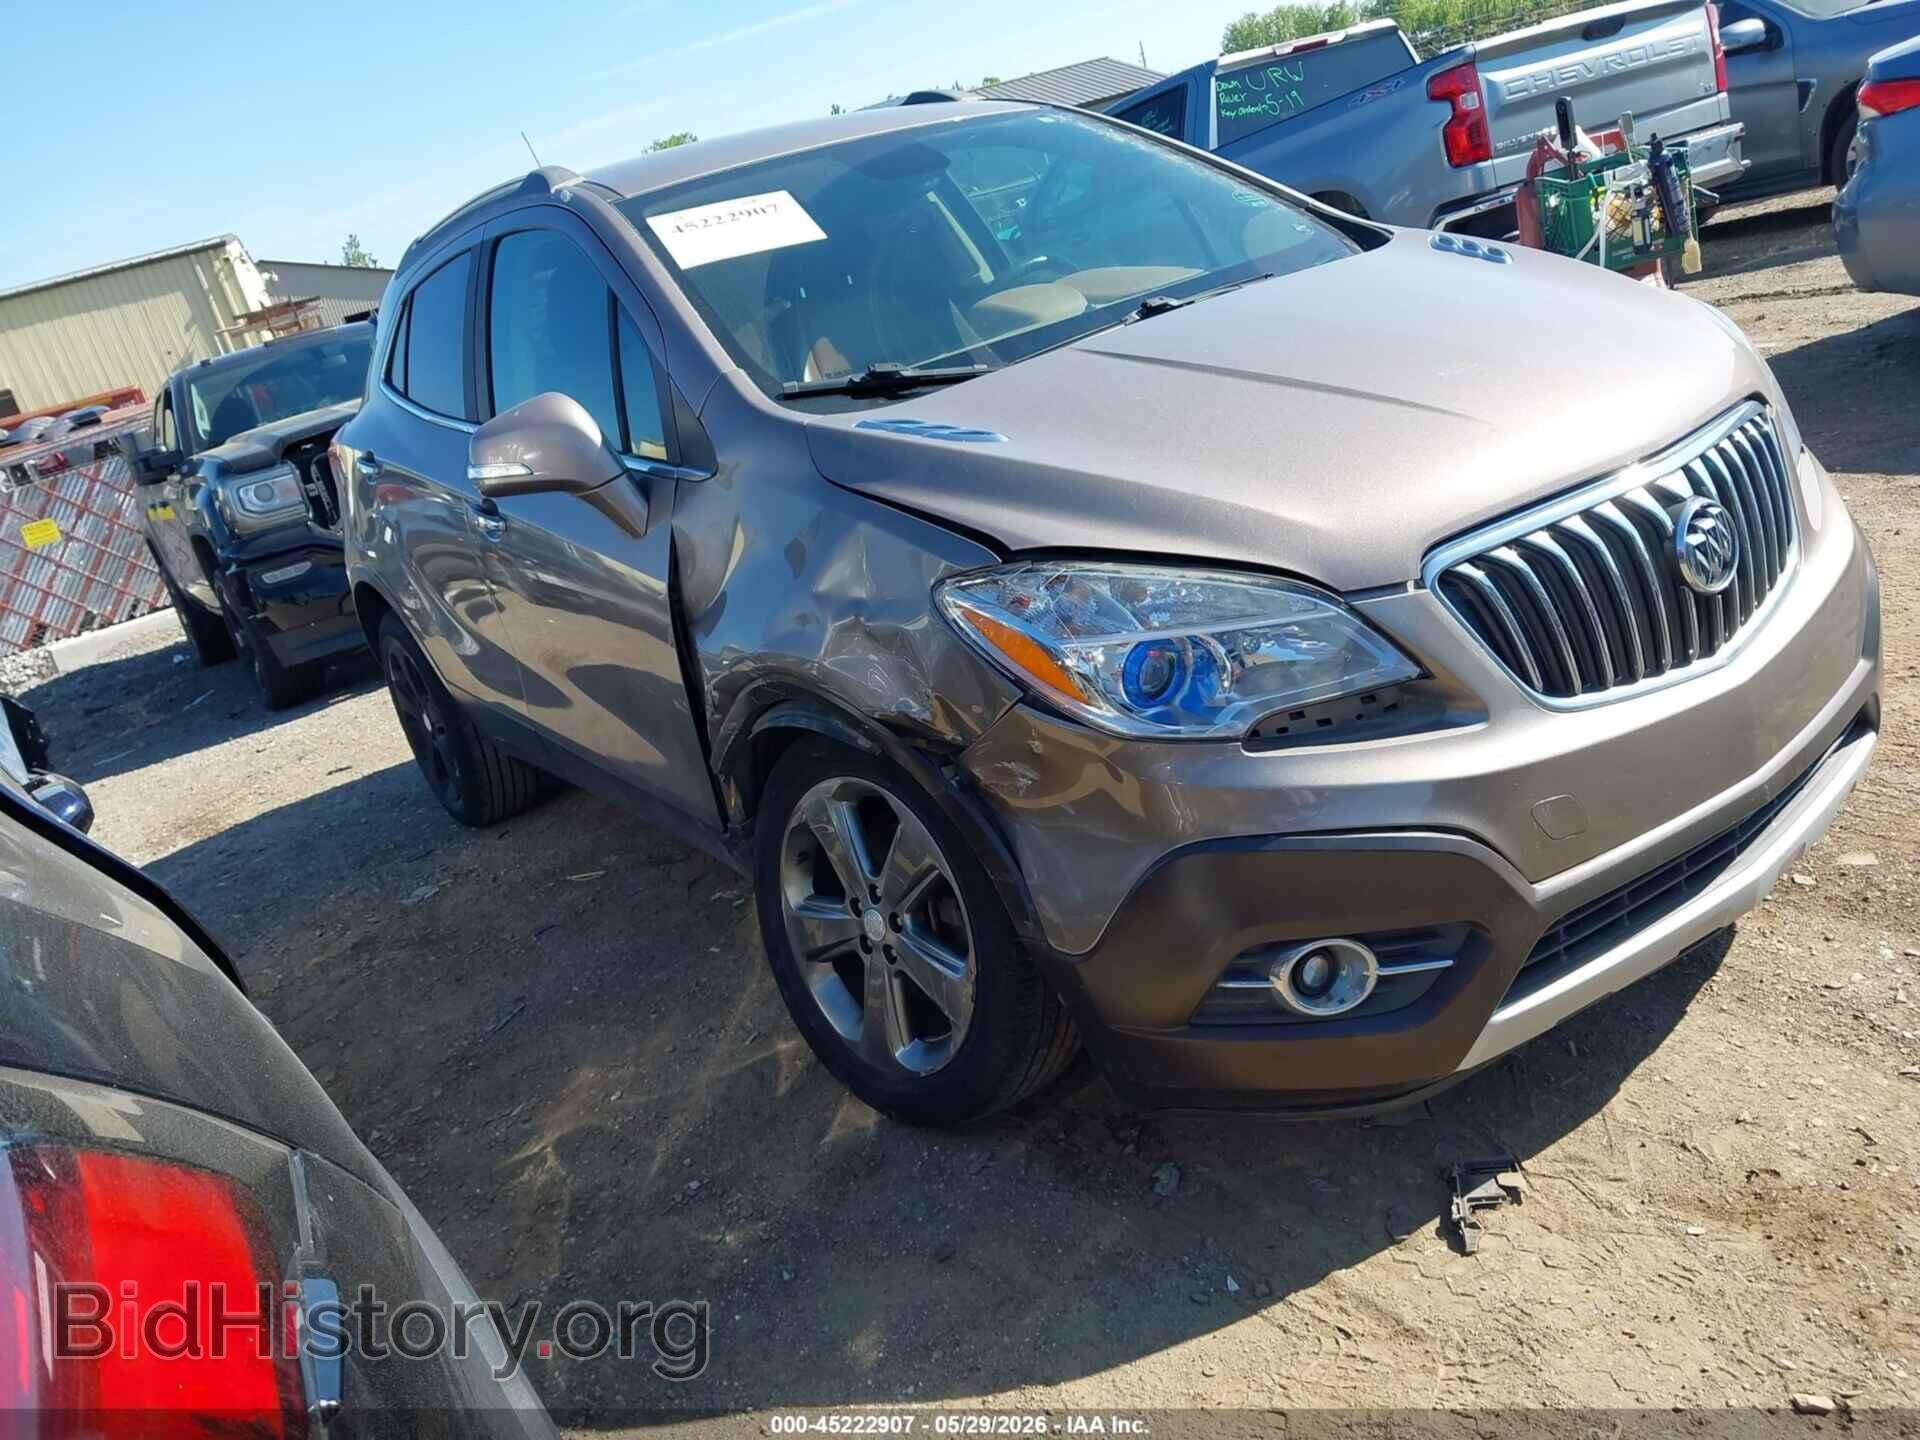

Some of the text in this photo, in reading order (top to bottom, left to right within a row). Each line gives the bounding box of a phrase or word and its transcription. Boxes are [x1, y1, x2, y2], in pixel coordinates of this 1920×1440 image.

[1245, 61, 1304, 90] URW
[1504, 33, 1706, 101] CHEVROLET
[1265, 90, 1304, 115] 5-19
[672, 202, 779, 234] 45222907
